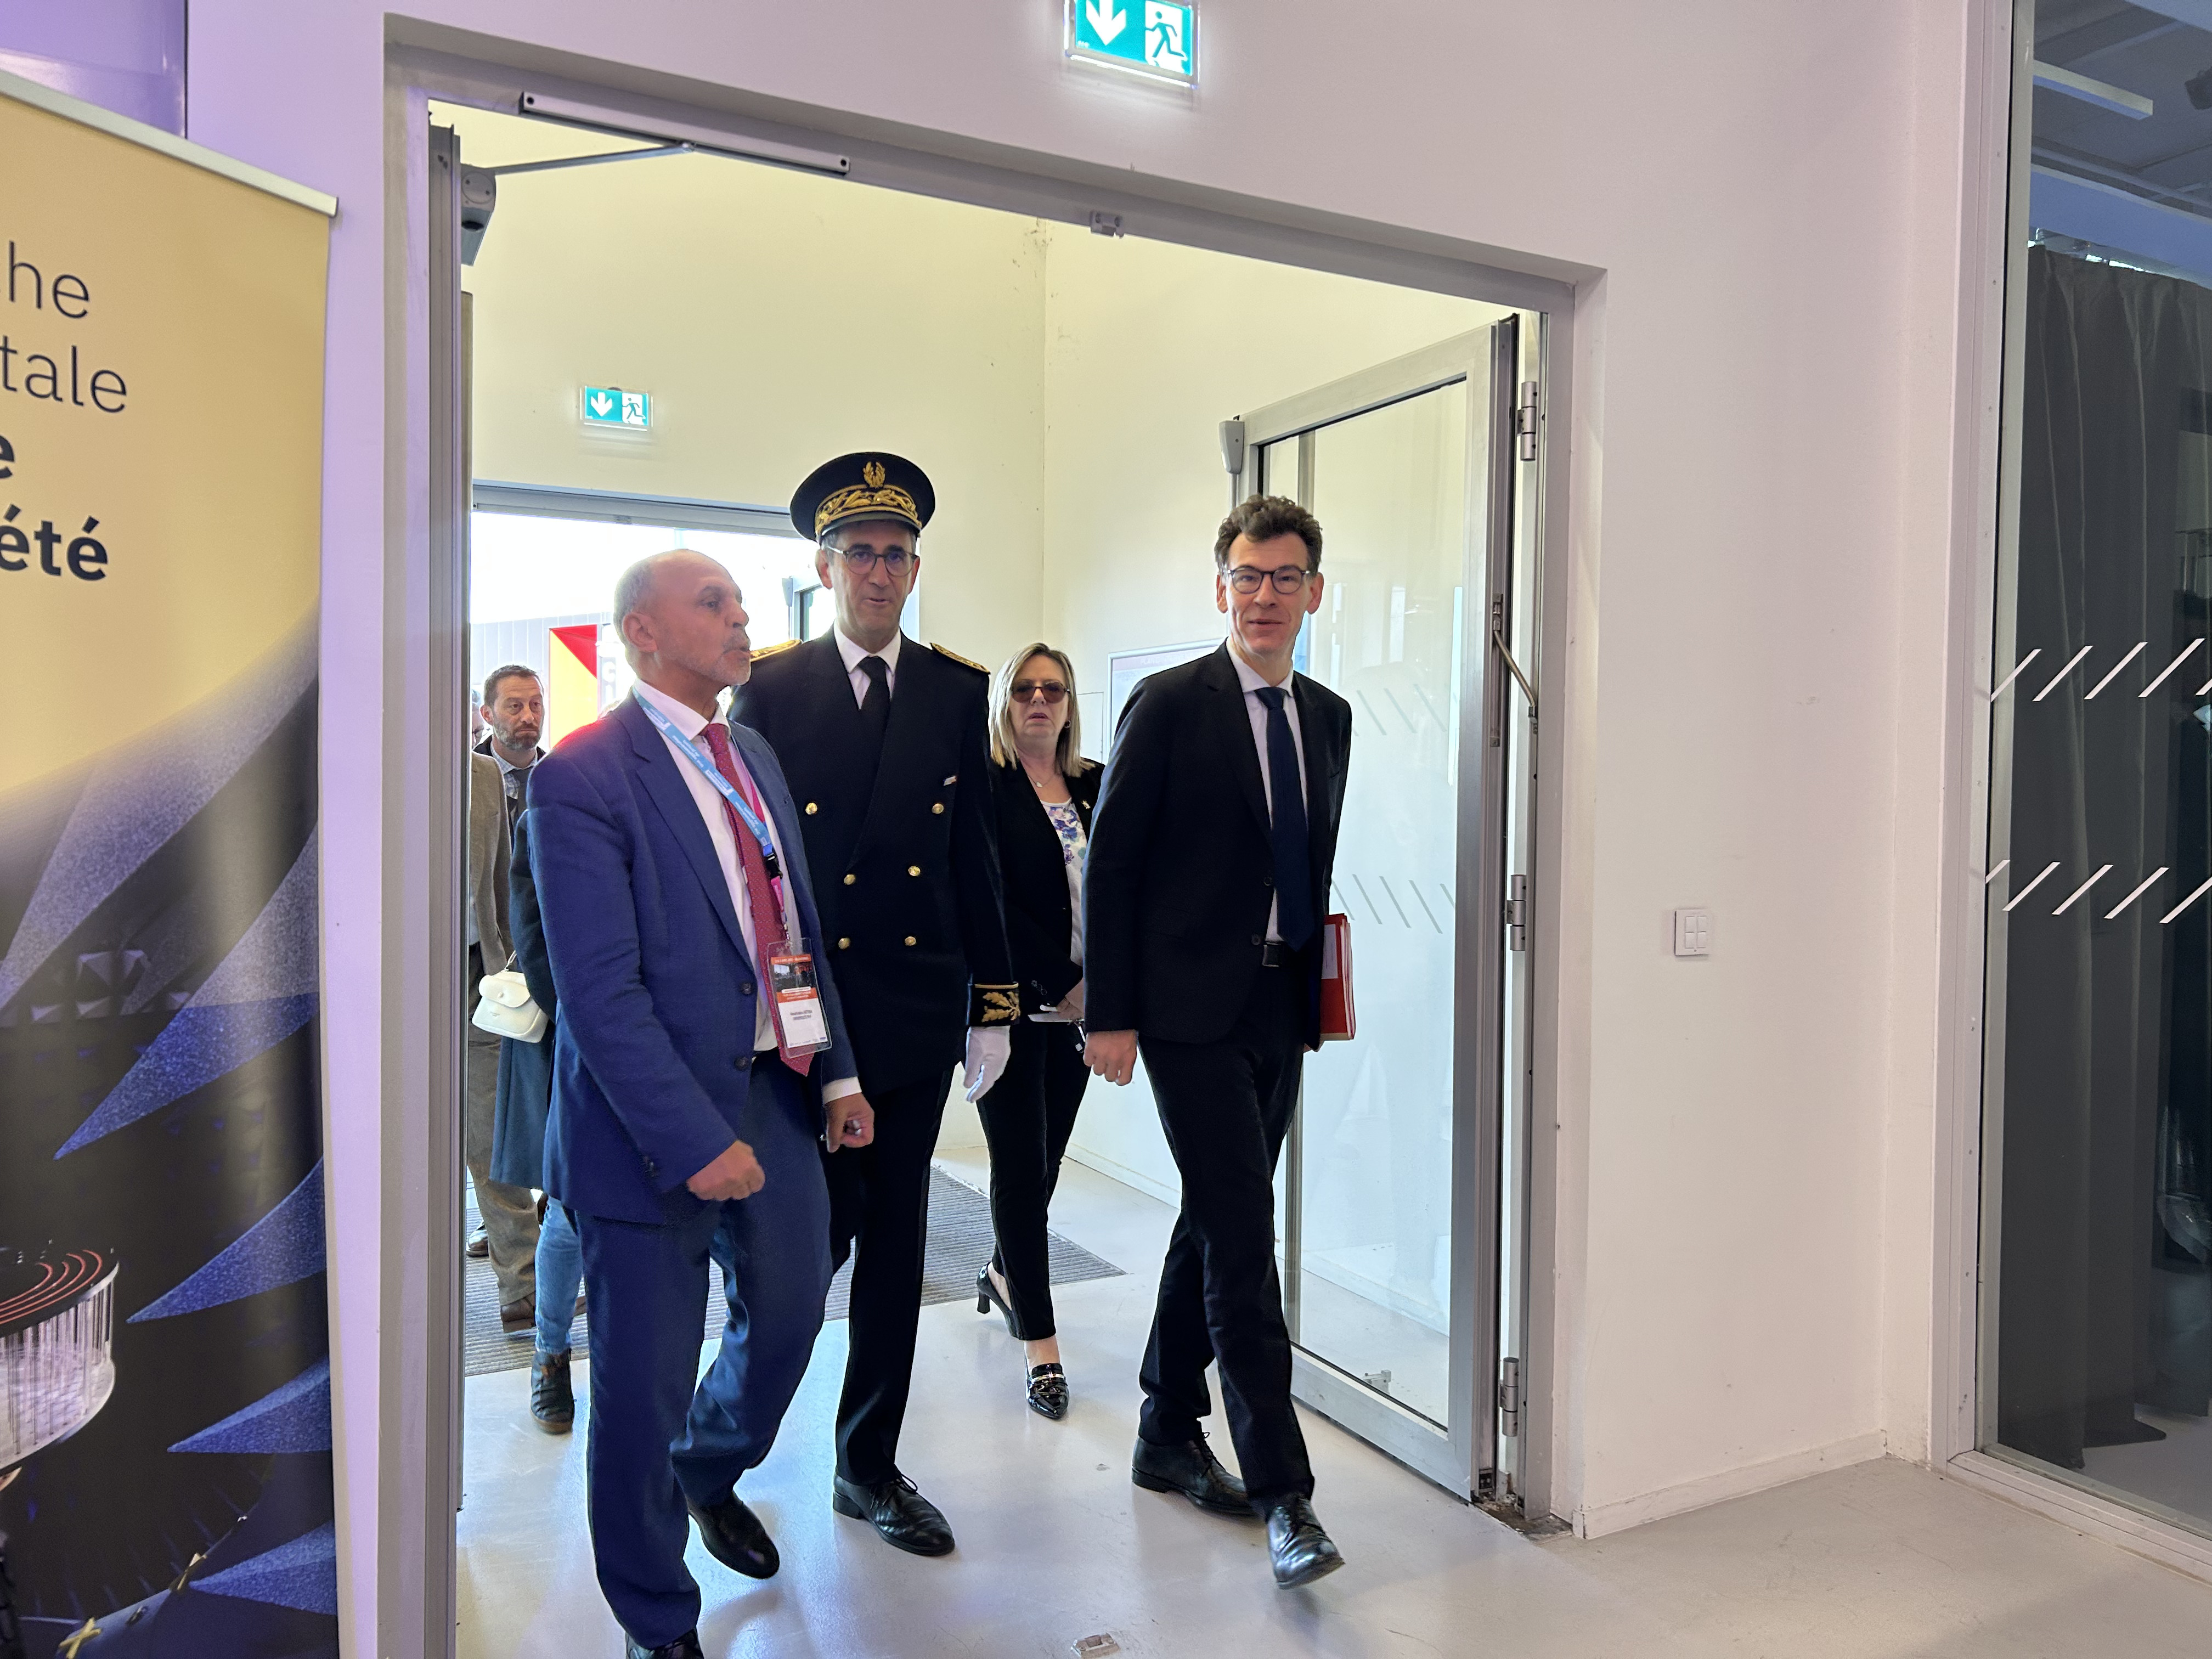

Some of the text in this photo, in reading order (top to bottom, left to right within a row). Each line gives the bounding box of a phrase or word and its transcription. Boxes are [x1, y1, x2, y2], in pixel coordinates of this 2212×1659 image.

[9, 240, 89, 319] he
[0, 335, 126, 413] tale
[0, 503, 108, 581] été
